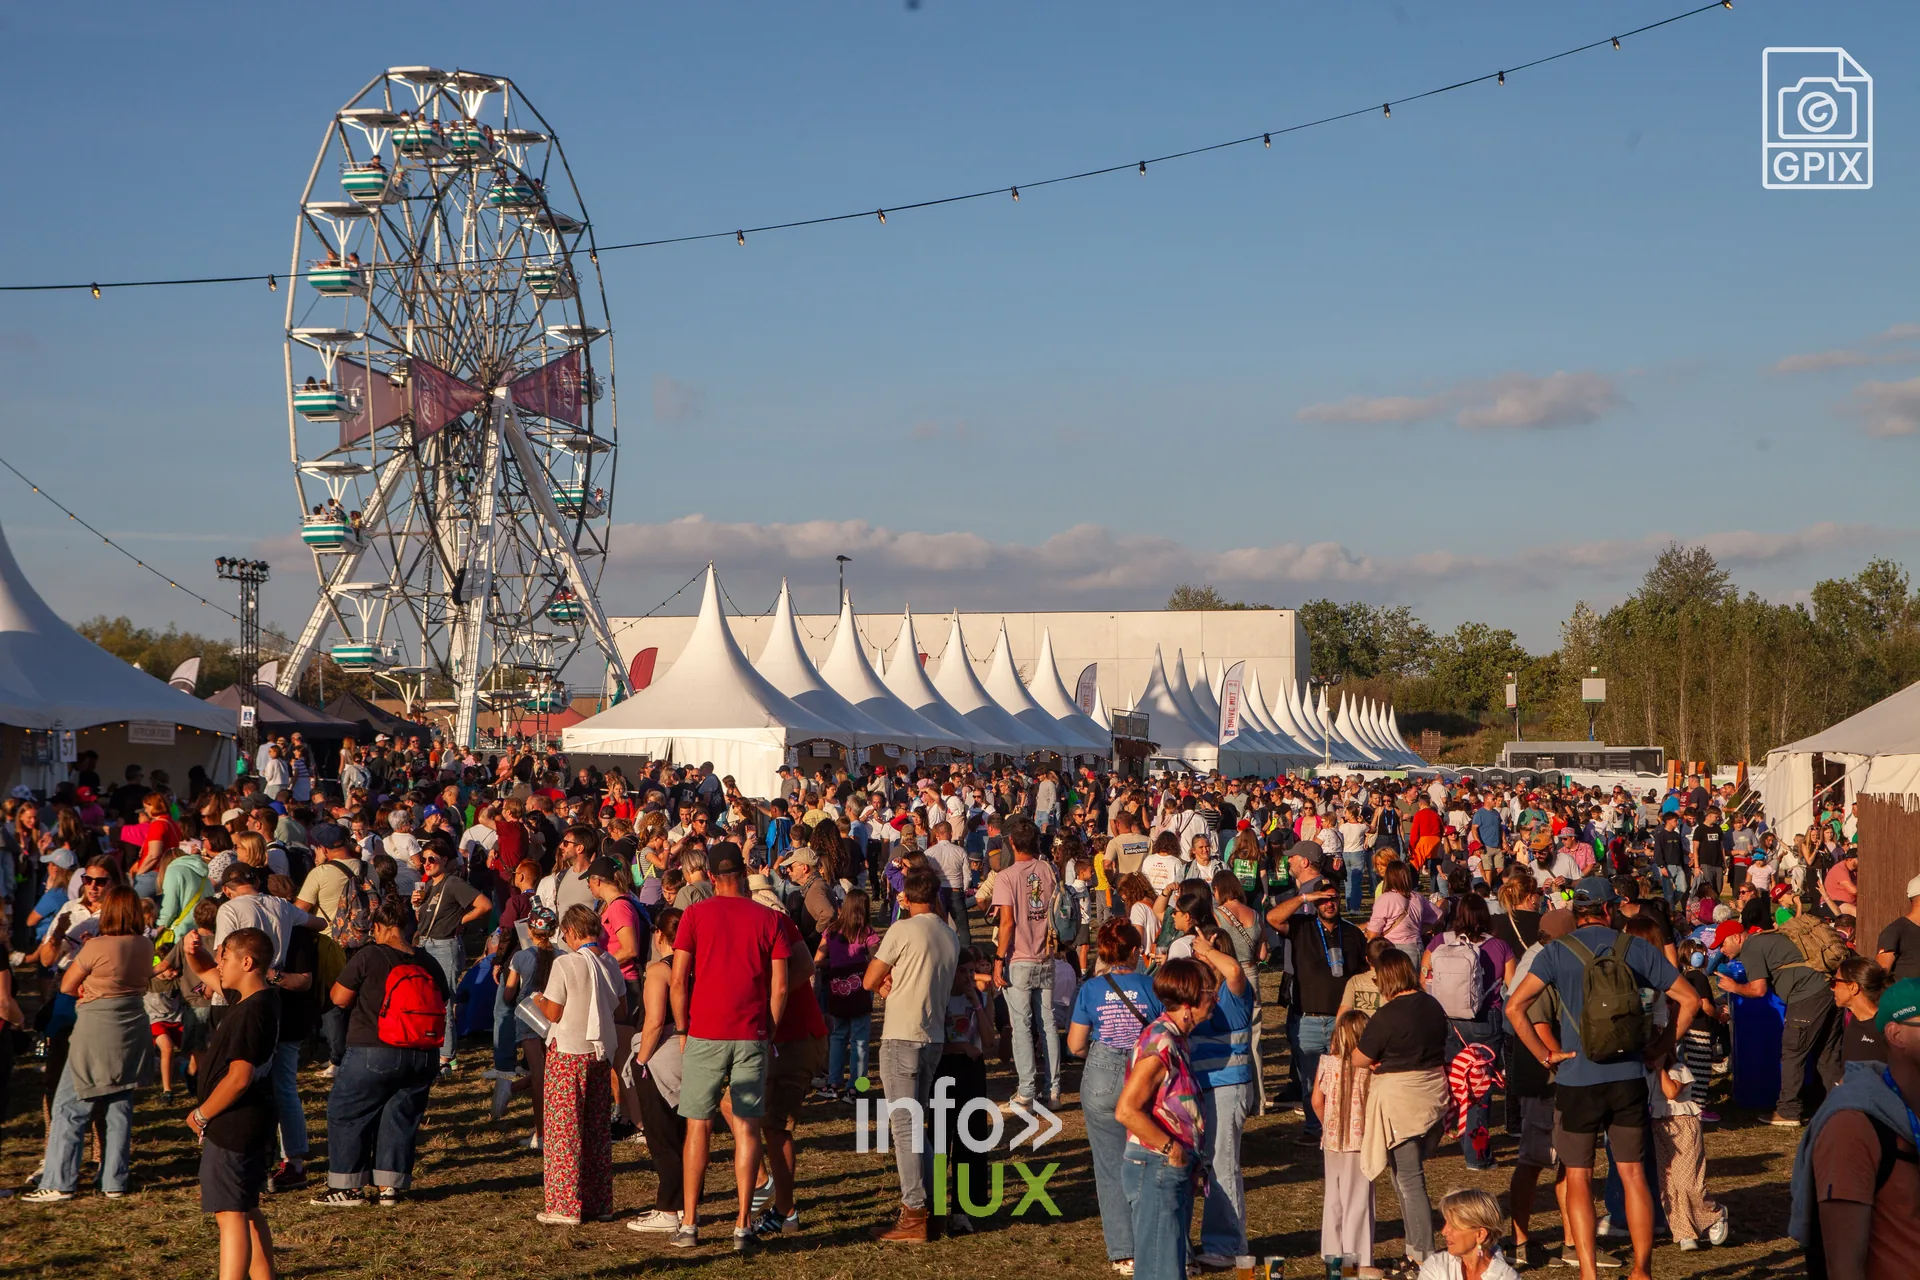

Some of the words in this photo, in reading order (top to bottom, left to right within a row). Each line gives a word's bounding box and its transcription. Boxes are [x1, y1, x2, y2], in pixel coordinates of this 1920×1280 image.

[1229, 692, 1237, 705] MUT
[1227, 707, 1236, 728] DRIVE
[62, 738, 74, 756] 37
[1892, 1006, 1917, 1019] aramco
